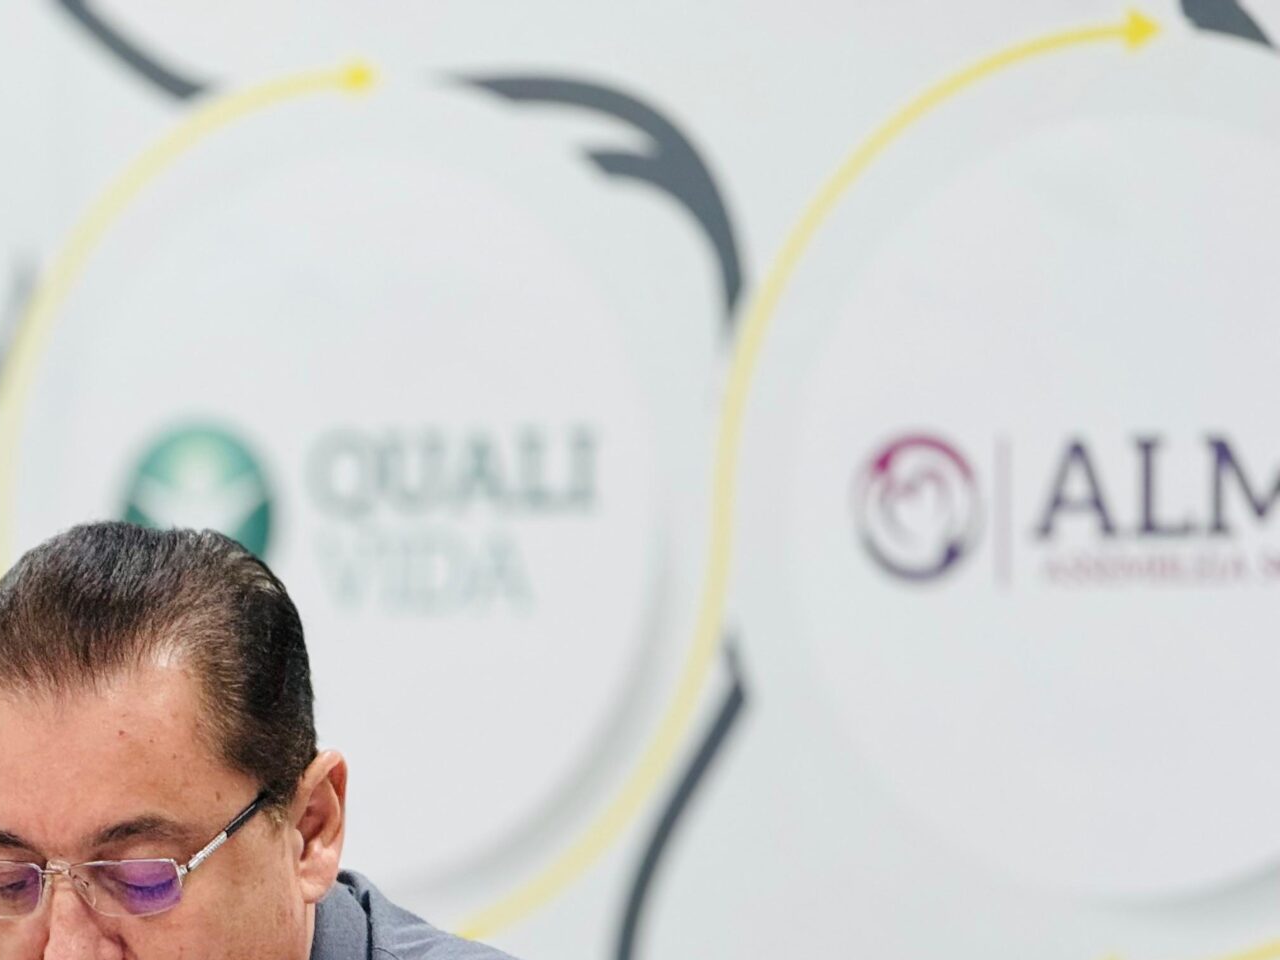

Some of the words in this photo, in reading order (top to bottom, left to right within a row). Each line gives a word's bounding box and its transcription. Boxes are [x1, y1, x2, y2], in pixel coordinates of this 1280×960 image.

[307, 424, 596, 518] QUALI
[1034, 434, 1280, 537] ALM
[316, 527, 536, 613] VIDA
